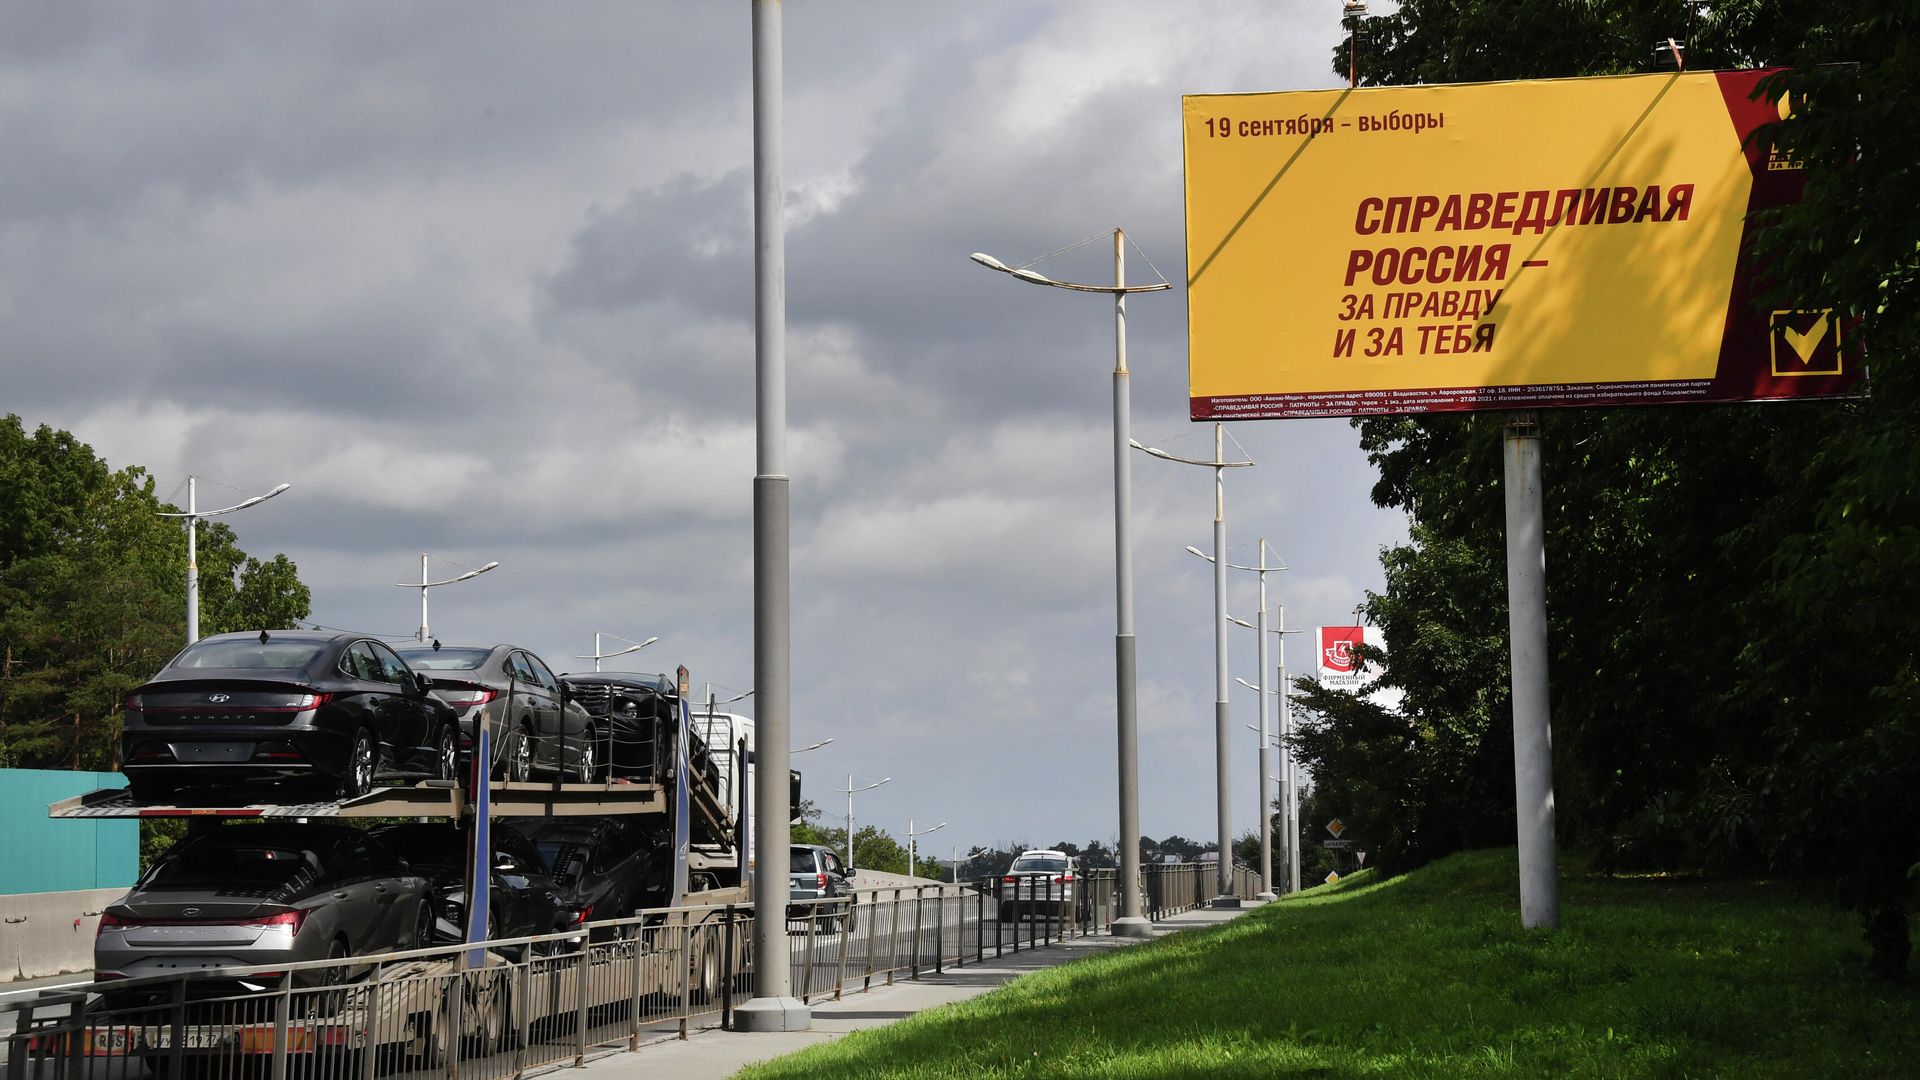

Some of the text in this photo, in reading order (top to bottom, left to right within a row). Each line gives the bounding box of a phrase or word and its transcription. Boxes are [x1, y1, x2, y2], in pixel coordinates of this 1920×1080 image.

[1205, 117, 1231, 138] 19
[1238, 113, 1334, 139] сентября
[1358, 109, 1444, 134] выборы
[1354, 183, 1695, 236] СПРАВЕДЛИВАЯ
[1344, 243, 1512, 287] РОССИЯ
[1338, 288, 1504, 321] ЗА ПРАВДУ
[1332, 323, 1496, 358] И ЗА ТЕБЯ
[1597, 390, 1642, 398] избирательного
